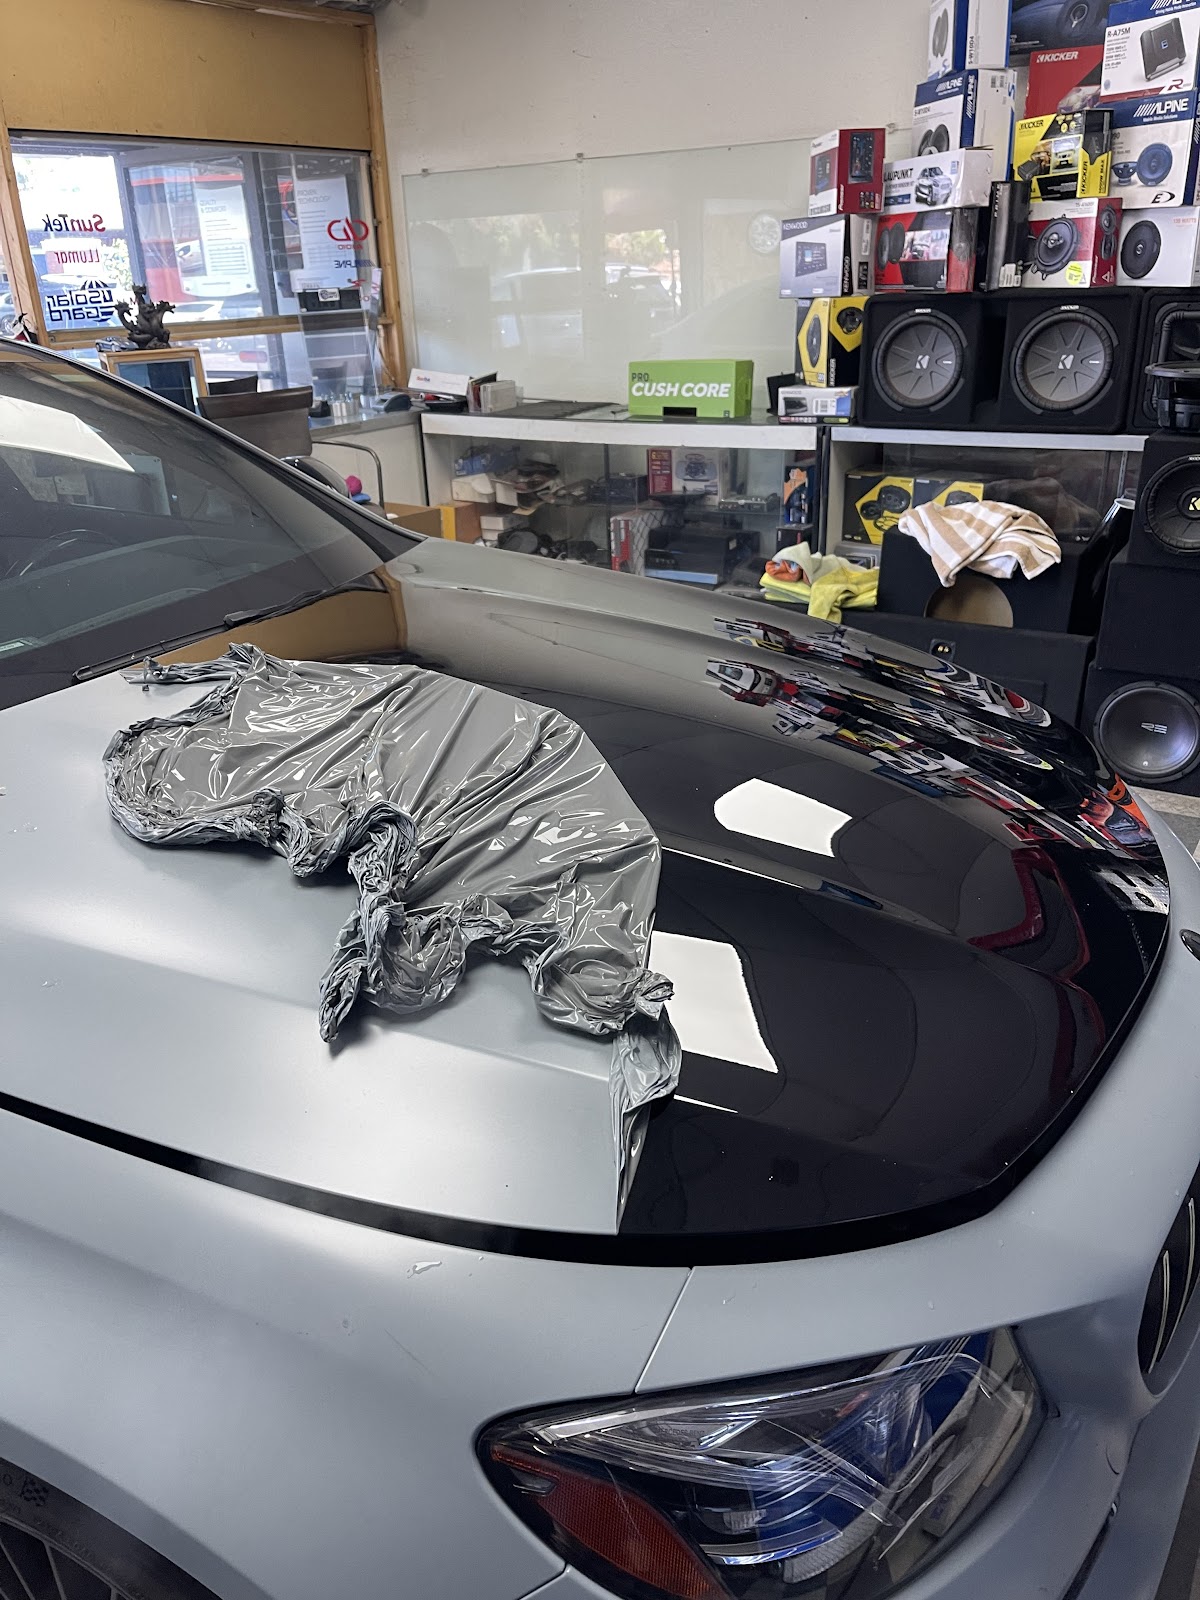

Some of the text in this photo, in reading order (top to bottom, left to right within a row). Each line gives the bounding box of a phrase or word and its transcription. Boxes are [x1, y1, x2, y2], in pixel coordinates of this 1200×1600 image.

[1107, 27, 1131, 37] R-A75M
[1042, 51, 1079, 62] KICKER
[1136, 98, 1189, 117] ALPINE
[884, 168, 914, 181] LAUPUNKT
[631, 373, 649, 382] PRO
[631, 382, 731, 398] CUSH CORE
